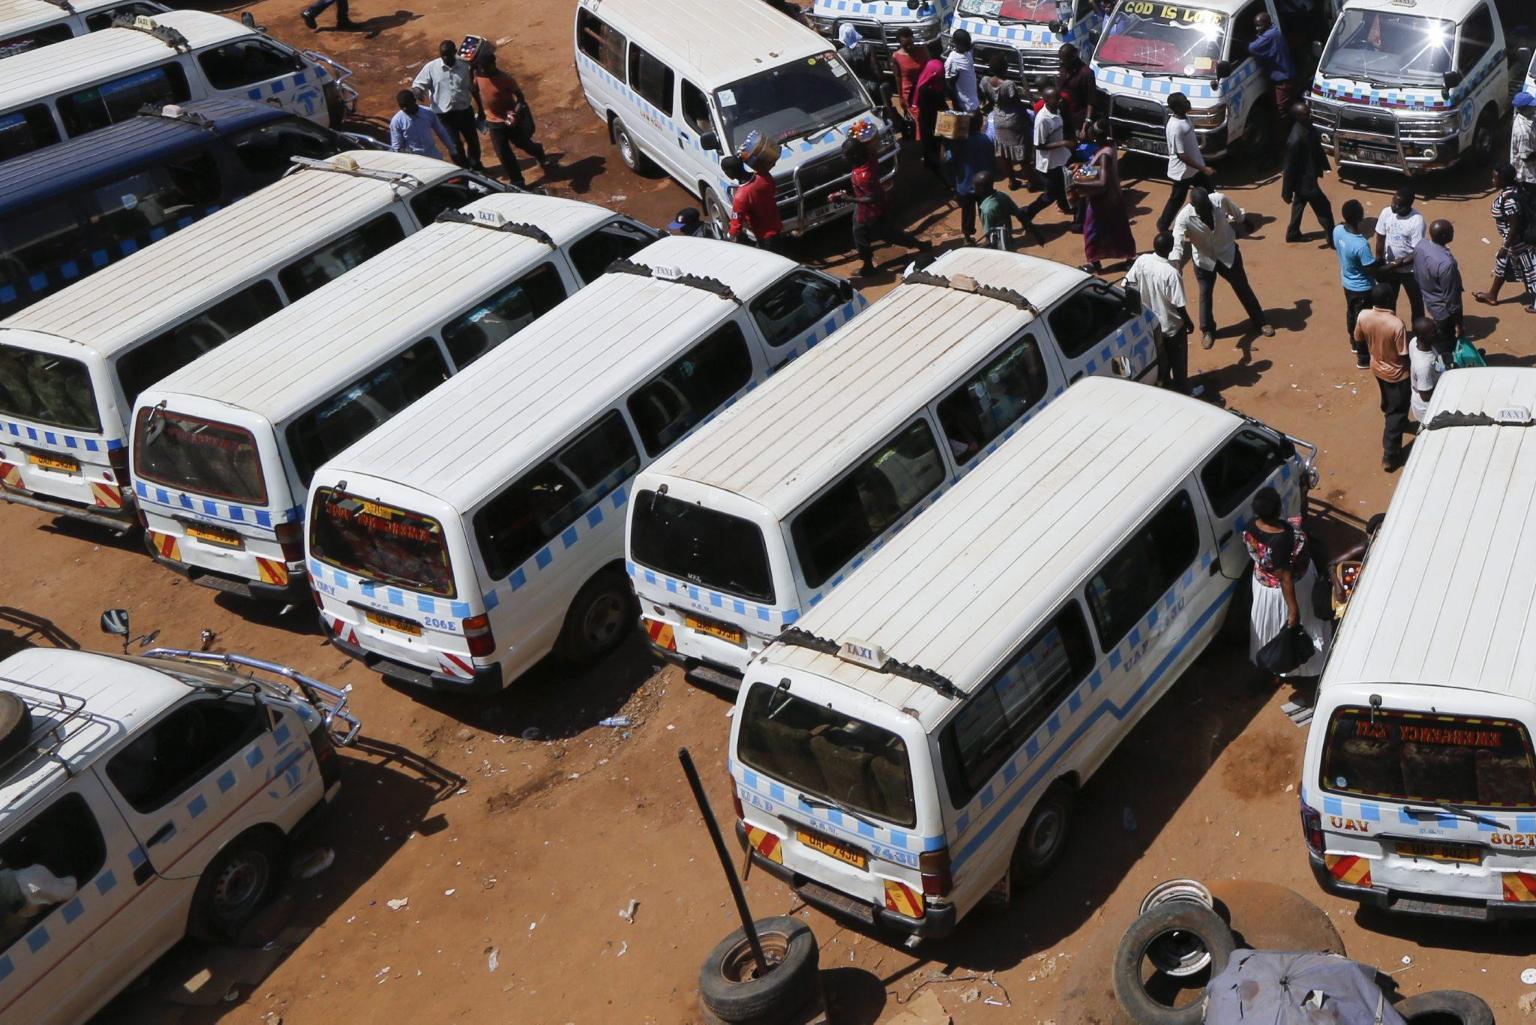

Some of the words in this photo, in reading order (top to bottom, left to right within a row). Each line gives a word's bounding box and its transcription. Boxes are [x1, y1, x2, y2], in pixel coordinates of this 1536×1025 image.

[1125, 0, 1154, 15] GOD
[1160, 4, 1178, 18] IS
[479, 211, 496, 222] TAXI
[655, 265, 673, 277] TAXI
[1500, 407, 1525, 419] TAXI
[424, 617, 456, 631] 206E
[1330, 815, 1369, 833] UAV
[1490, 832, 1536, 847] 802T
